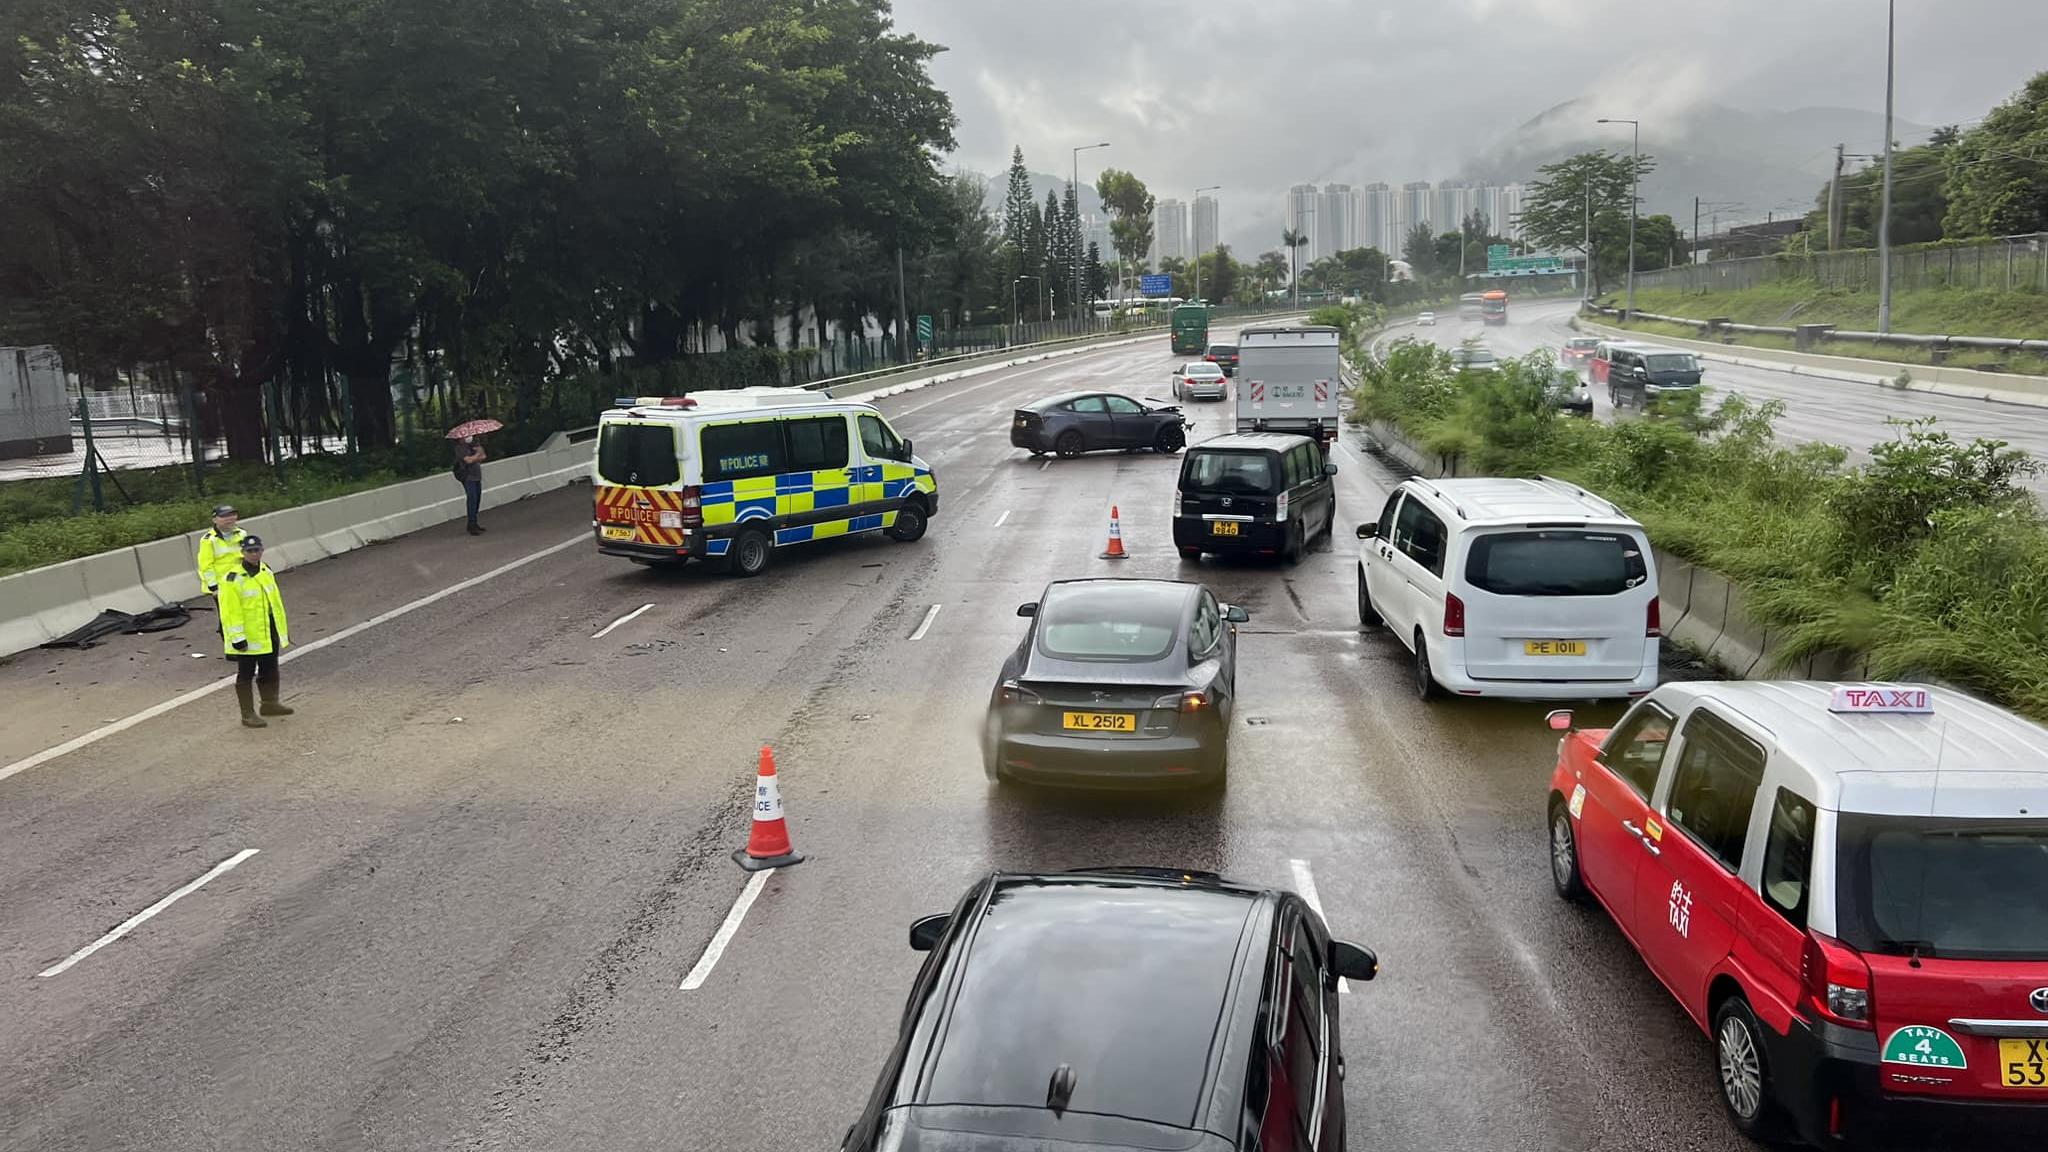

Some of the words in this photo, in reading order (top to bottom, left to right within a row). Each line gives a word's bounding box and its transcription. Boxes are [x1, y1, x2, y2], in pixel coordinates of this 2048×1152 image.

[728, 455, 758, 470] POLICE
[617, 507, 653, 522] POLICE
[1531, 642, 1550, 654] PE
[1555, 642, 1576, 653] 1011
[1846, 690, 1926, 708] TAXI
[1073, 715, 1089, 728] XL
[1092, 716, 1126, 729] 2512
[1670, 879, 1693, 916] 的士
[1669, 900, 1690, 939] TAXI
[1904, 1028, 1941, 1040] TAXI
[1915, 1038, 1932, 1055] 4
[2026, 1040, 2048, 1063] X
[1898, 1052, 1949, 1064] SEATS
